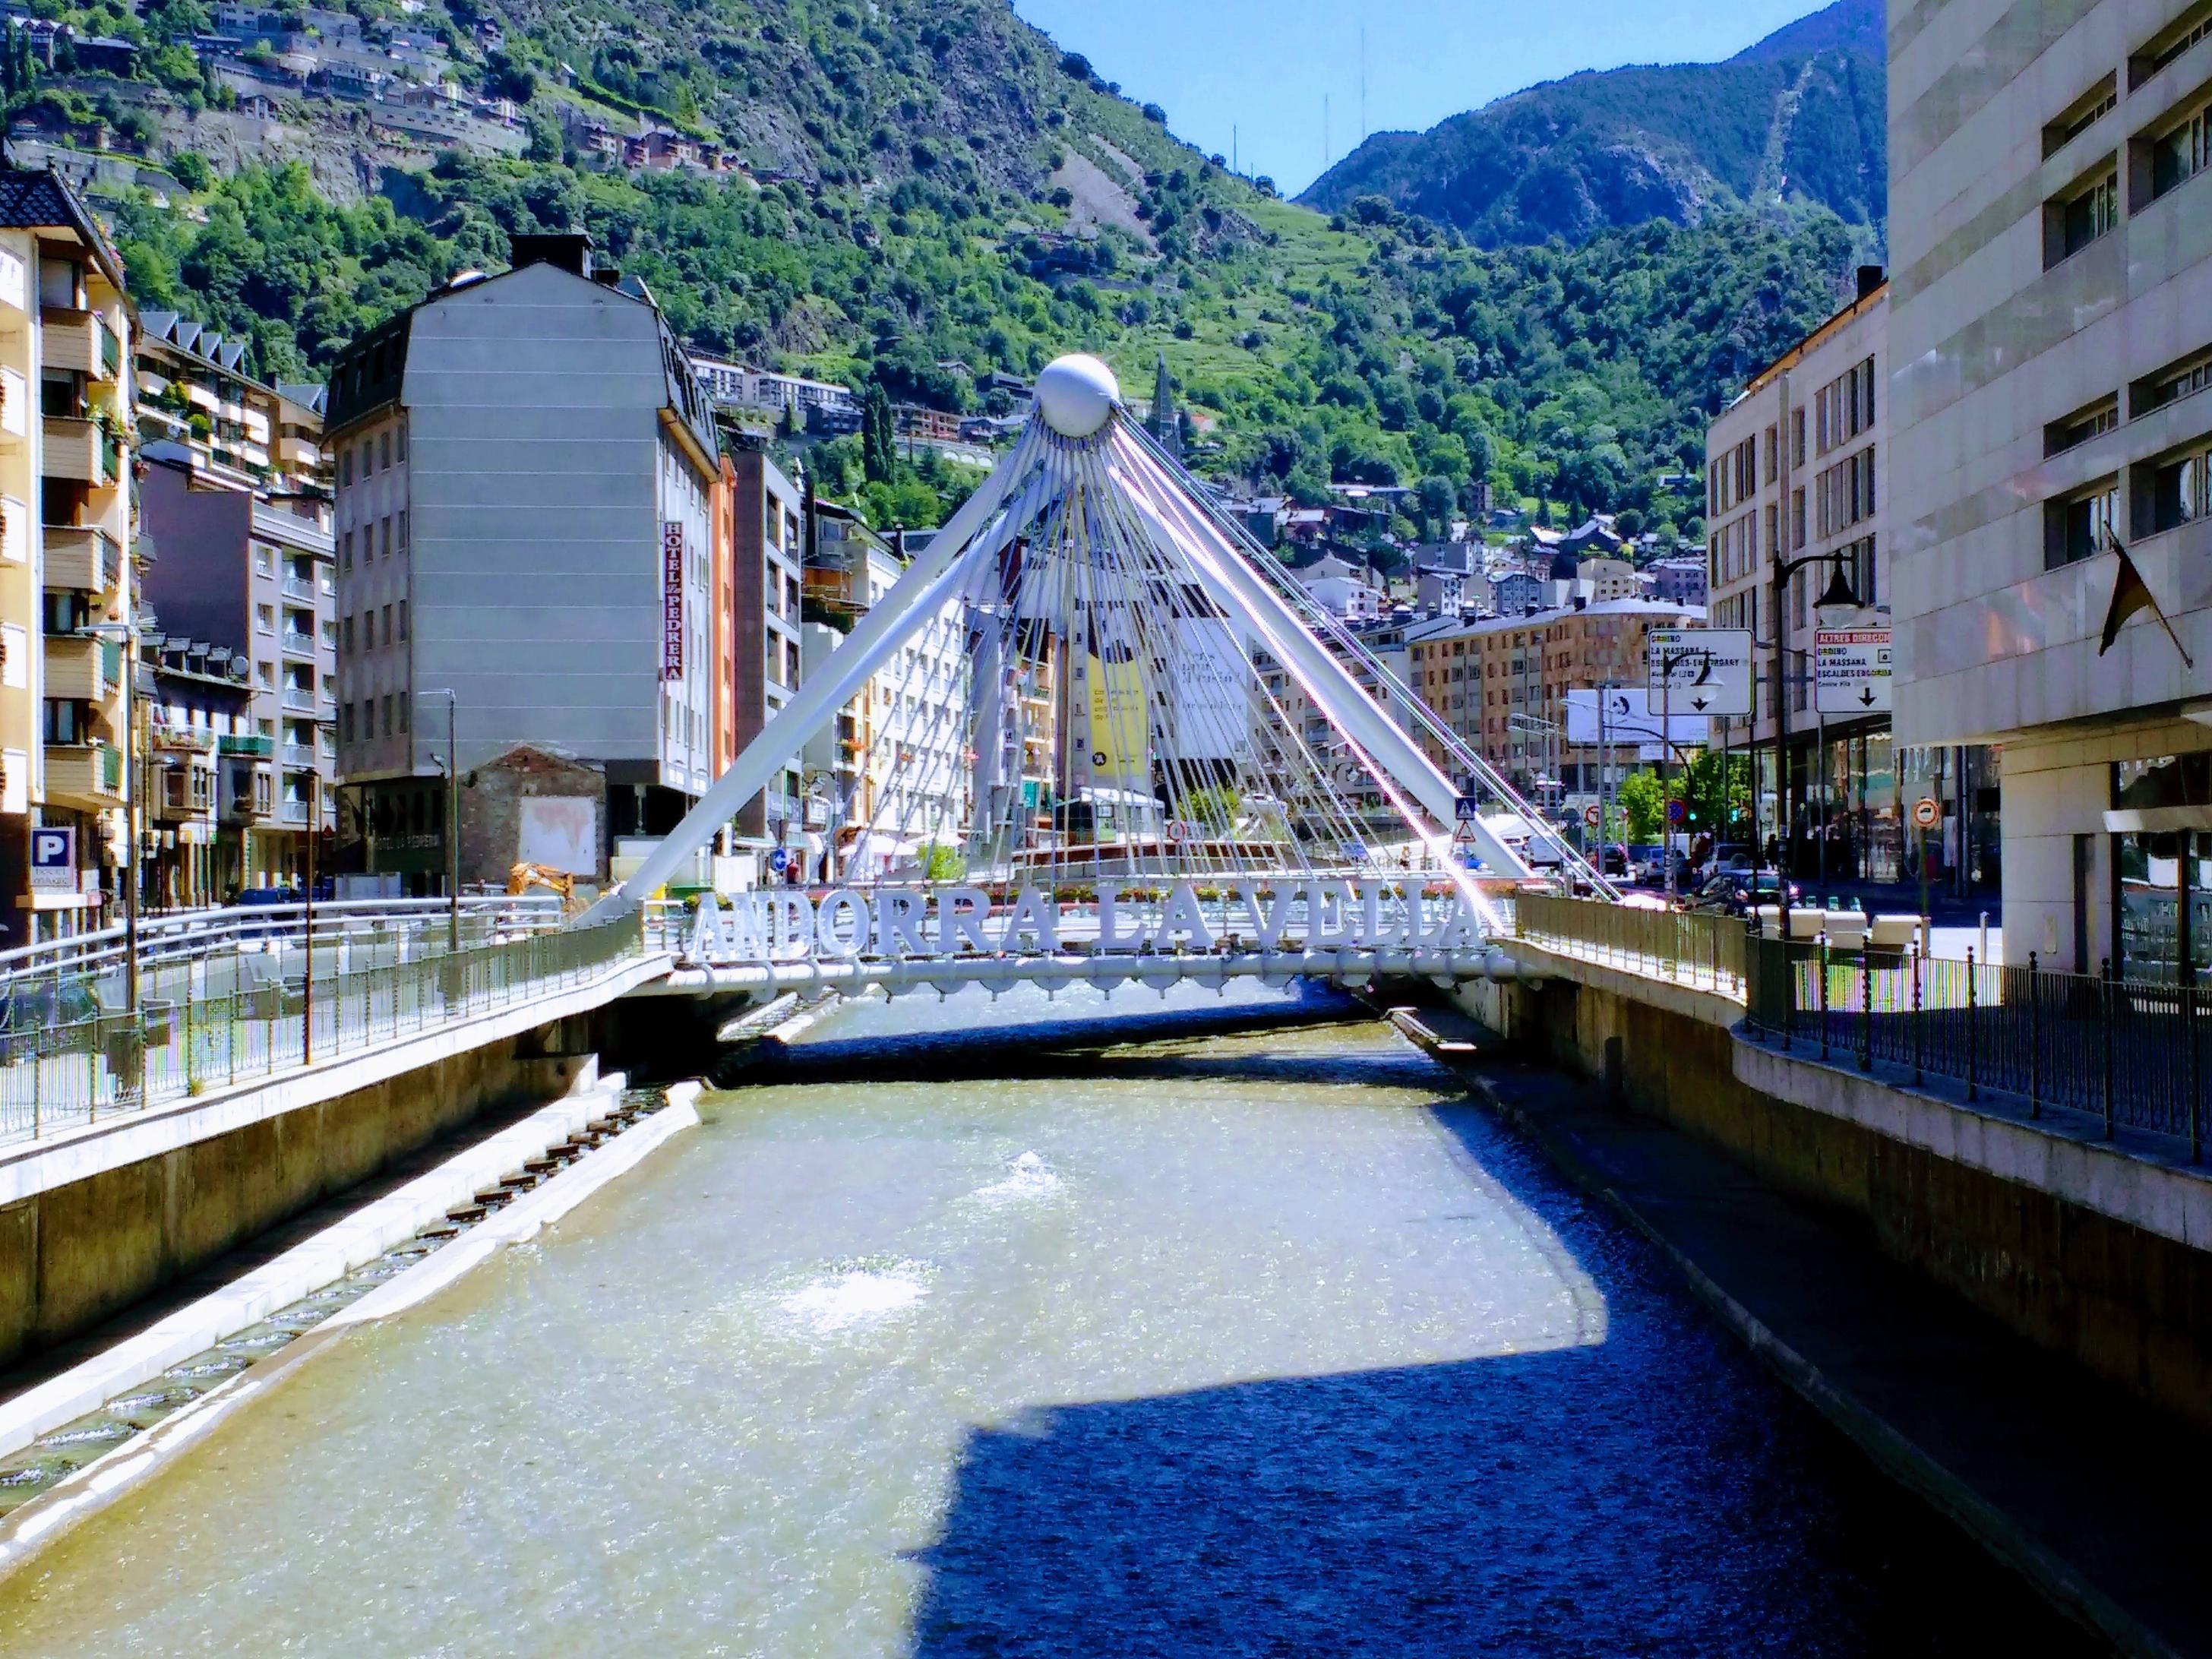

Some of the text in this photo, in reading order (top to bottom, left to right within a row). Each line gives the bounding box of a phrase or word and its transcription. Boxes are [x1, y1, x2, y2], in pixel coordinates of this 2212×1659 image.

[666, 523, 681, 583] HOTEL
[666, 595, 681, 680] PEDRERA
[36, 835, 65, 864] P
[688, 879, 1486, 959] ANDORRA LA VELLA
